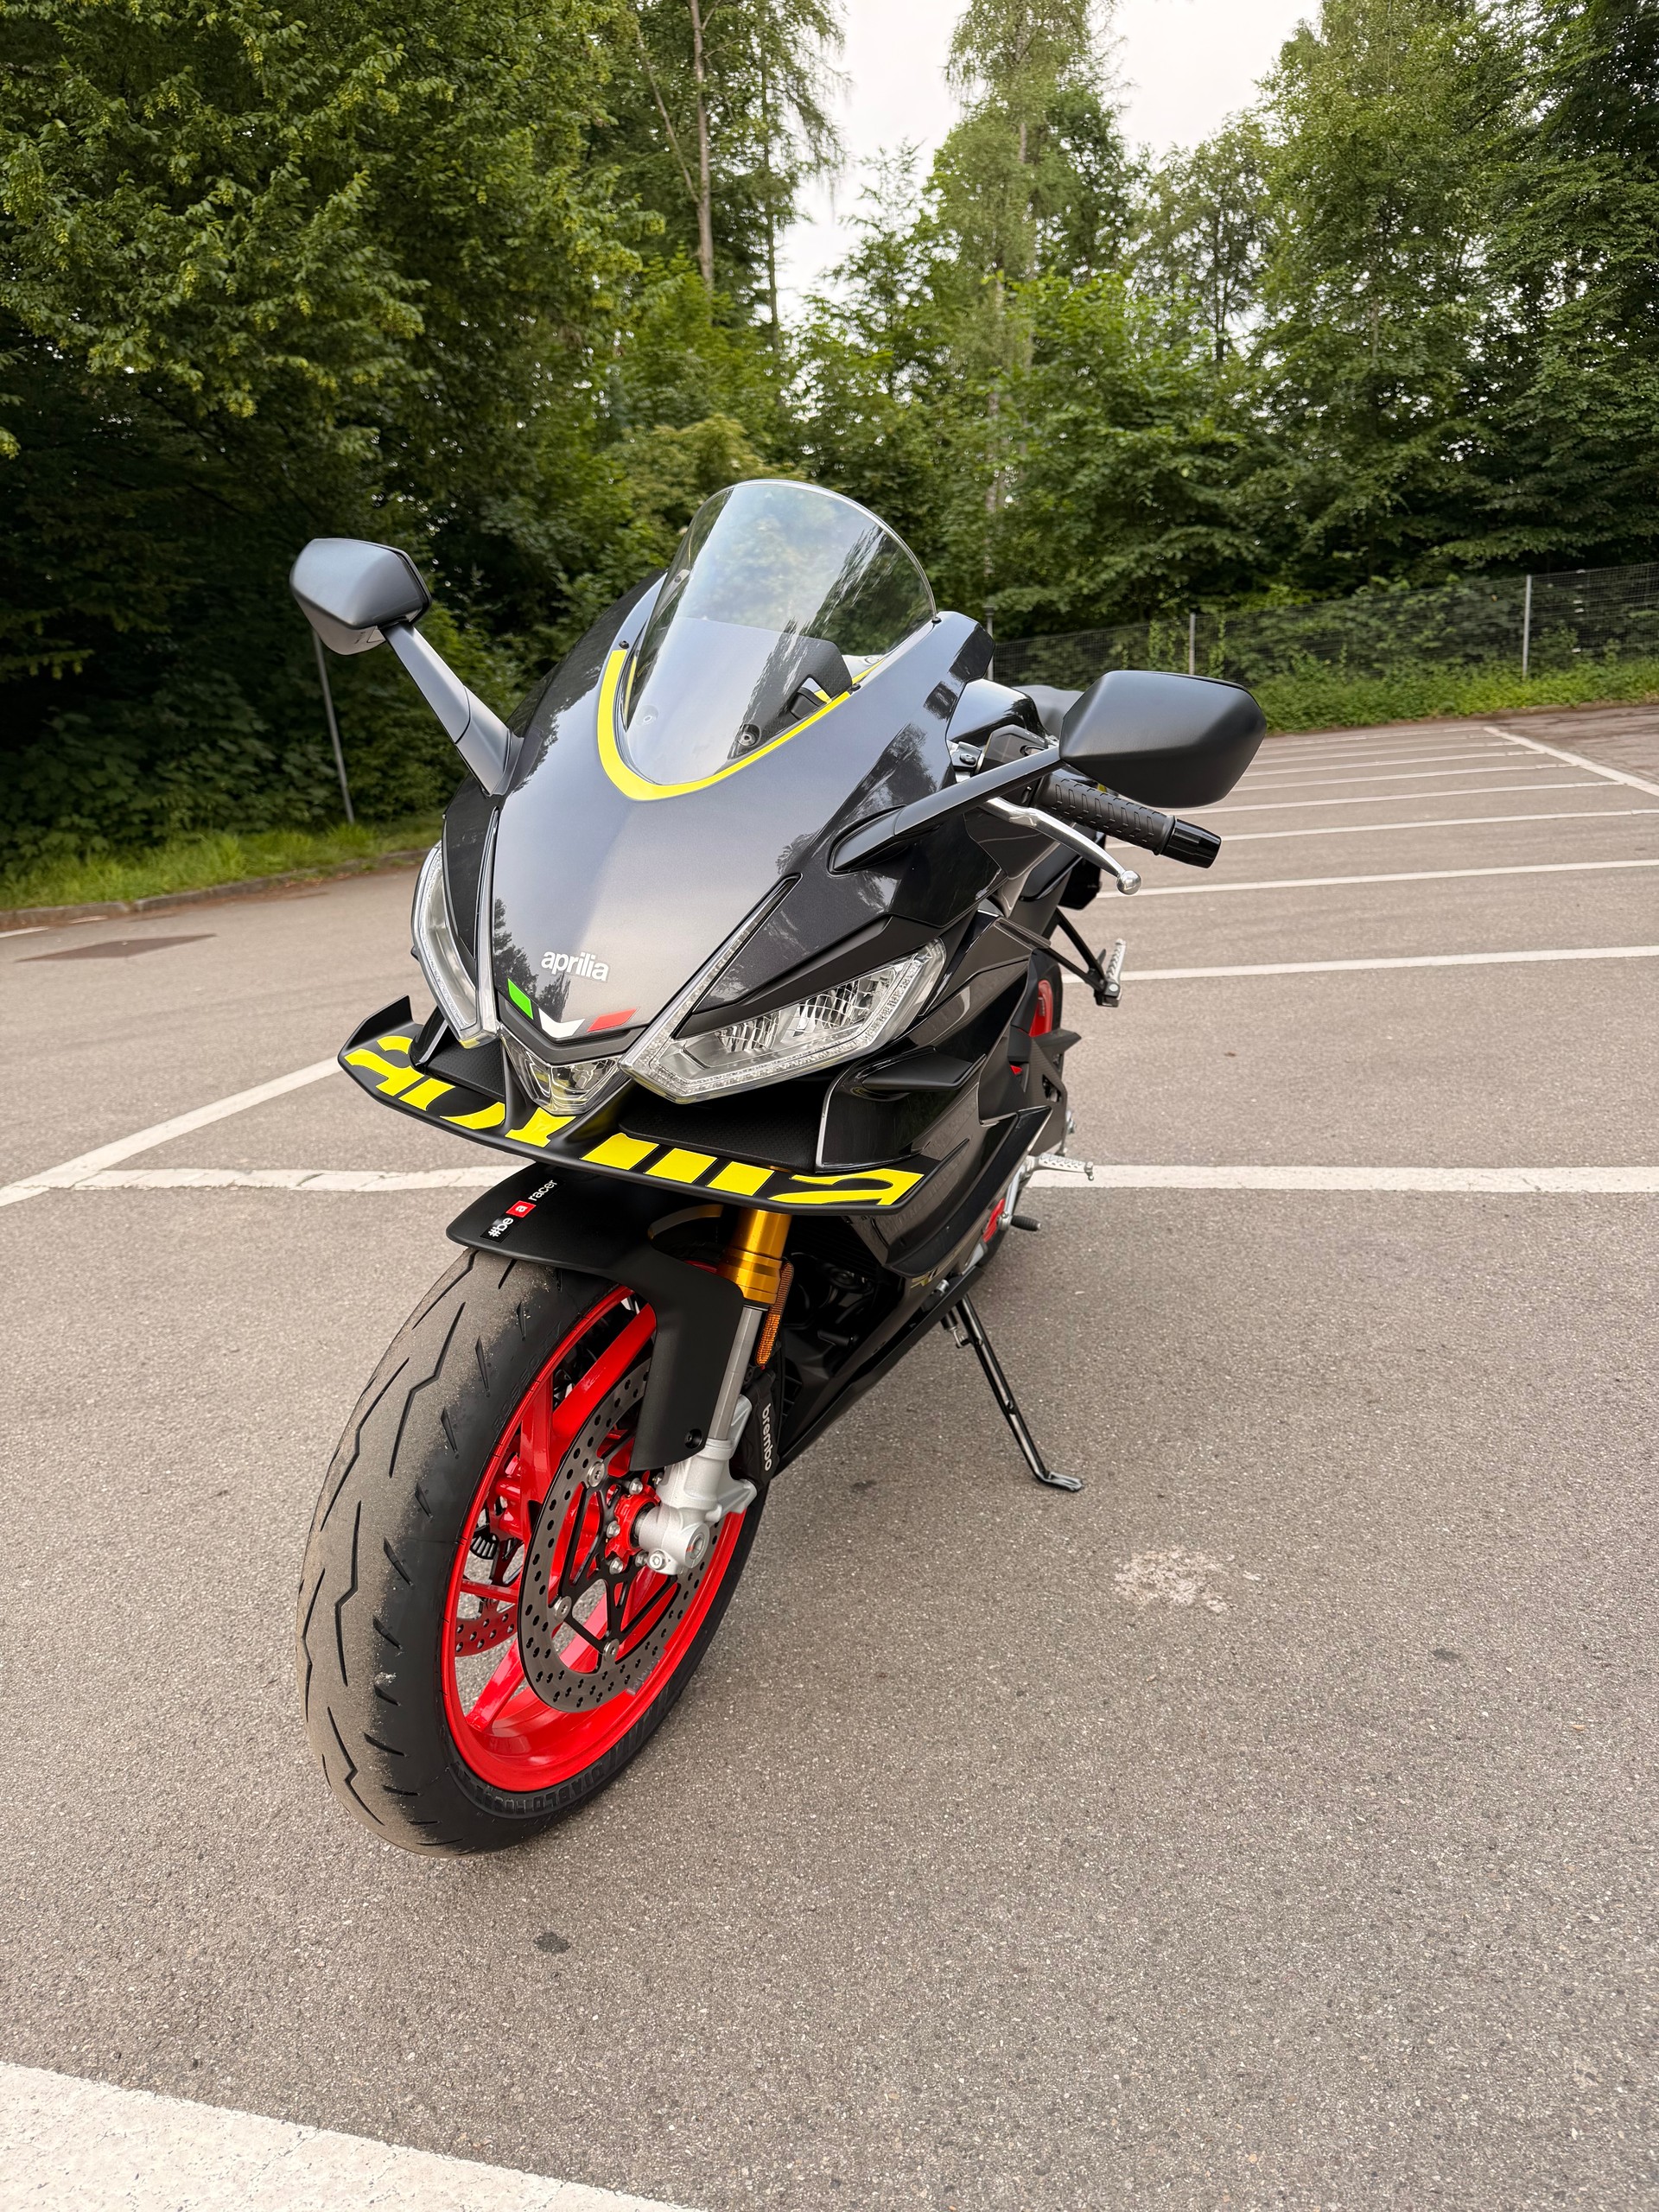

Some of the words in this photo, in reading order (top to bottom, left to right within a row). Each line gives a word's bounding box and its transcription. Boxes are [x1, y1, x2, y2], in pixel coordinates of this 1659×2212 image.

[541, 951, 609, 982] aprilia
[487, 1217, 514, 1237] #be
[515, 1205, 528, 1213] a
[528, 1179, 557, 1201] racer
[761, 1402, 773, 1471] brembo
